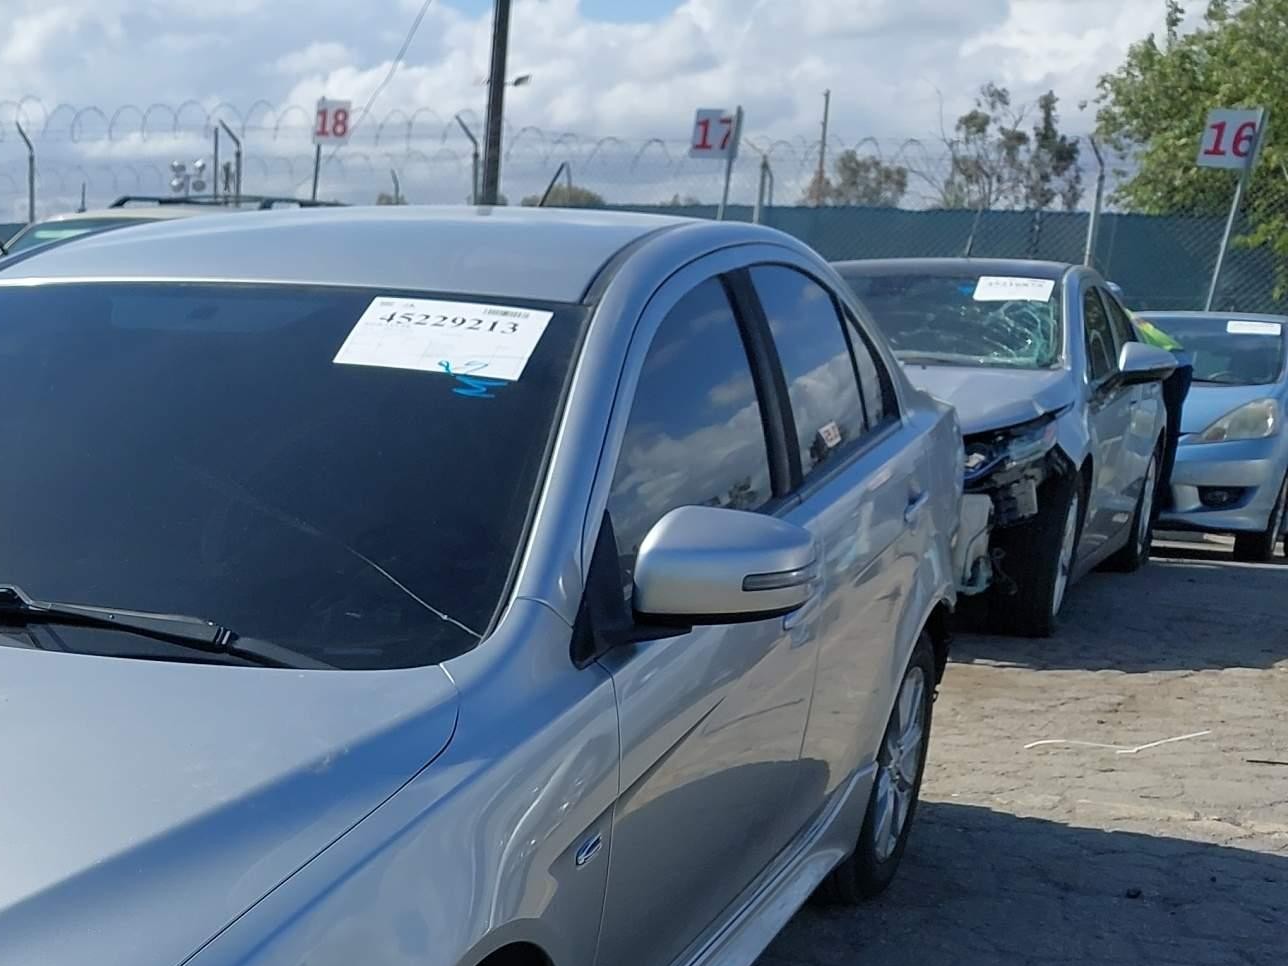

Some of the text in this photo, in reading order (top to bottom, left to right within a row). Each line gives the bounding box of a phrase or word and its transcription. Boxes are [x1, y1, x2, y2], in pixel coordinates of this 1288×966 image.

[314, 108, 350, 137] 18
[693, 117, 732, 150] 17
[1203, 120, 1257, 157] 16
[378, 311, 520, 335] 45229213
